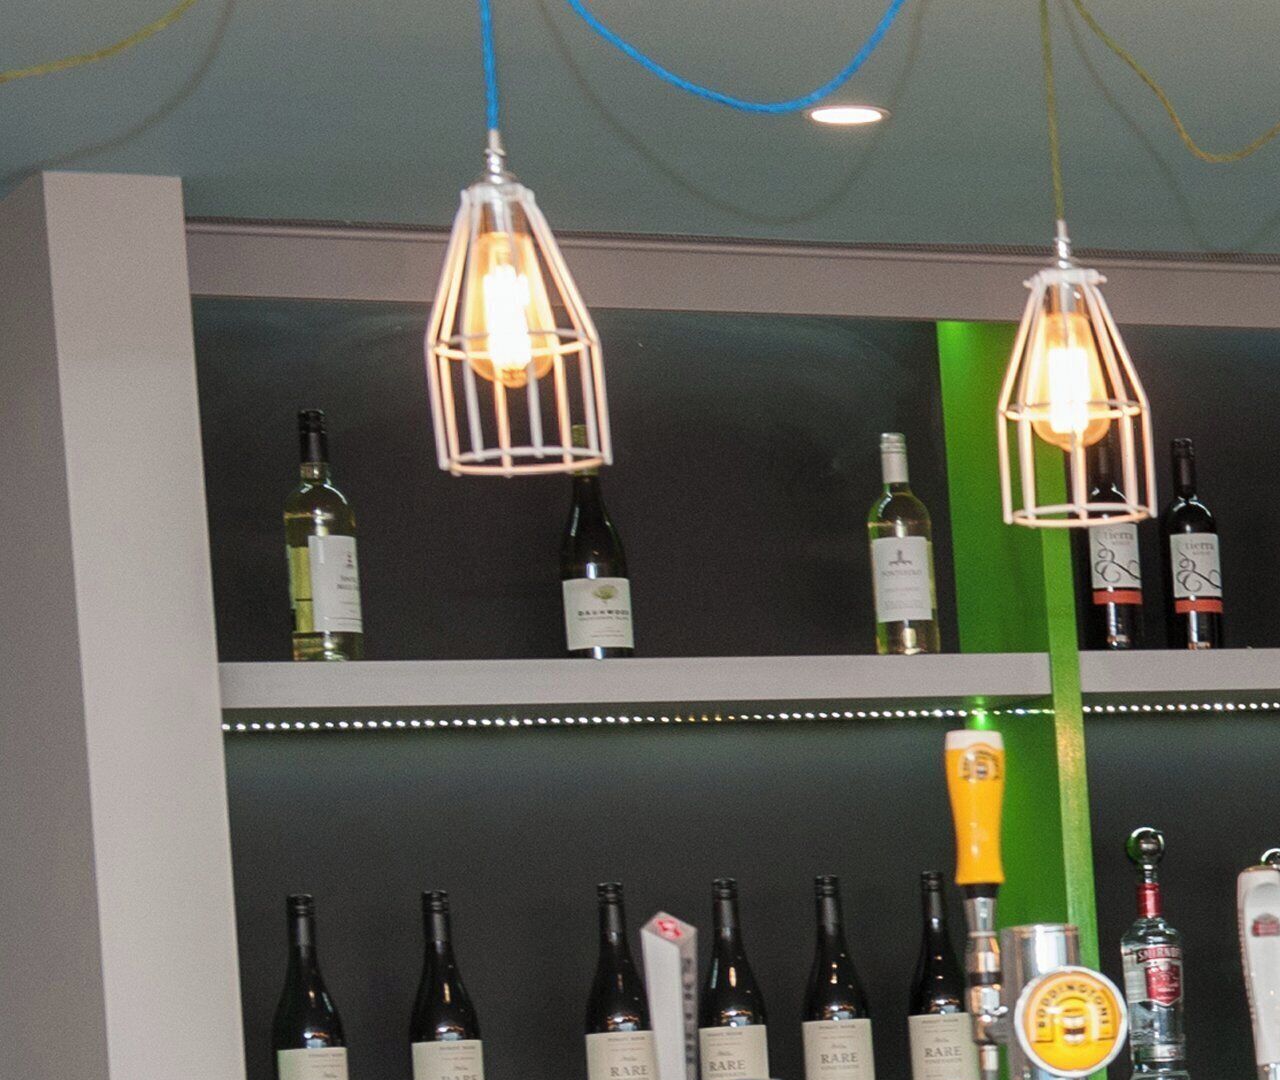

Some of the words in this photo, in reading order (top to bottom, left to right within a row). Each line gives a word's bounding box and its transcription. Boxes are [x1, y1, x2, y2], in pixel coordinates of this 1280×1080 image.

[925, 1046, 961, 1057] RARE
[821, 1052, 858, 1064] RARE
[610, 1065, 648, 1077] RARE
[709, 1060, 745, 1071] RARE
